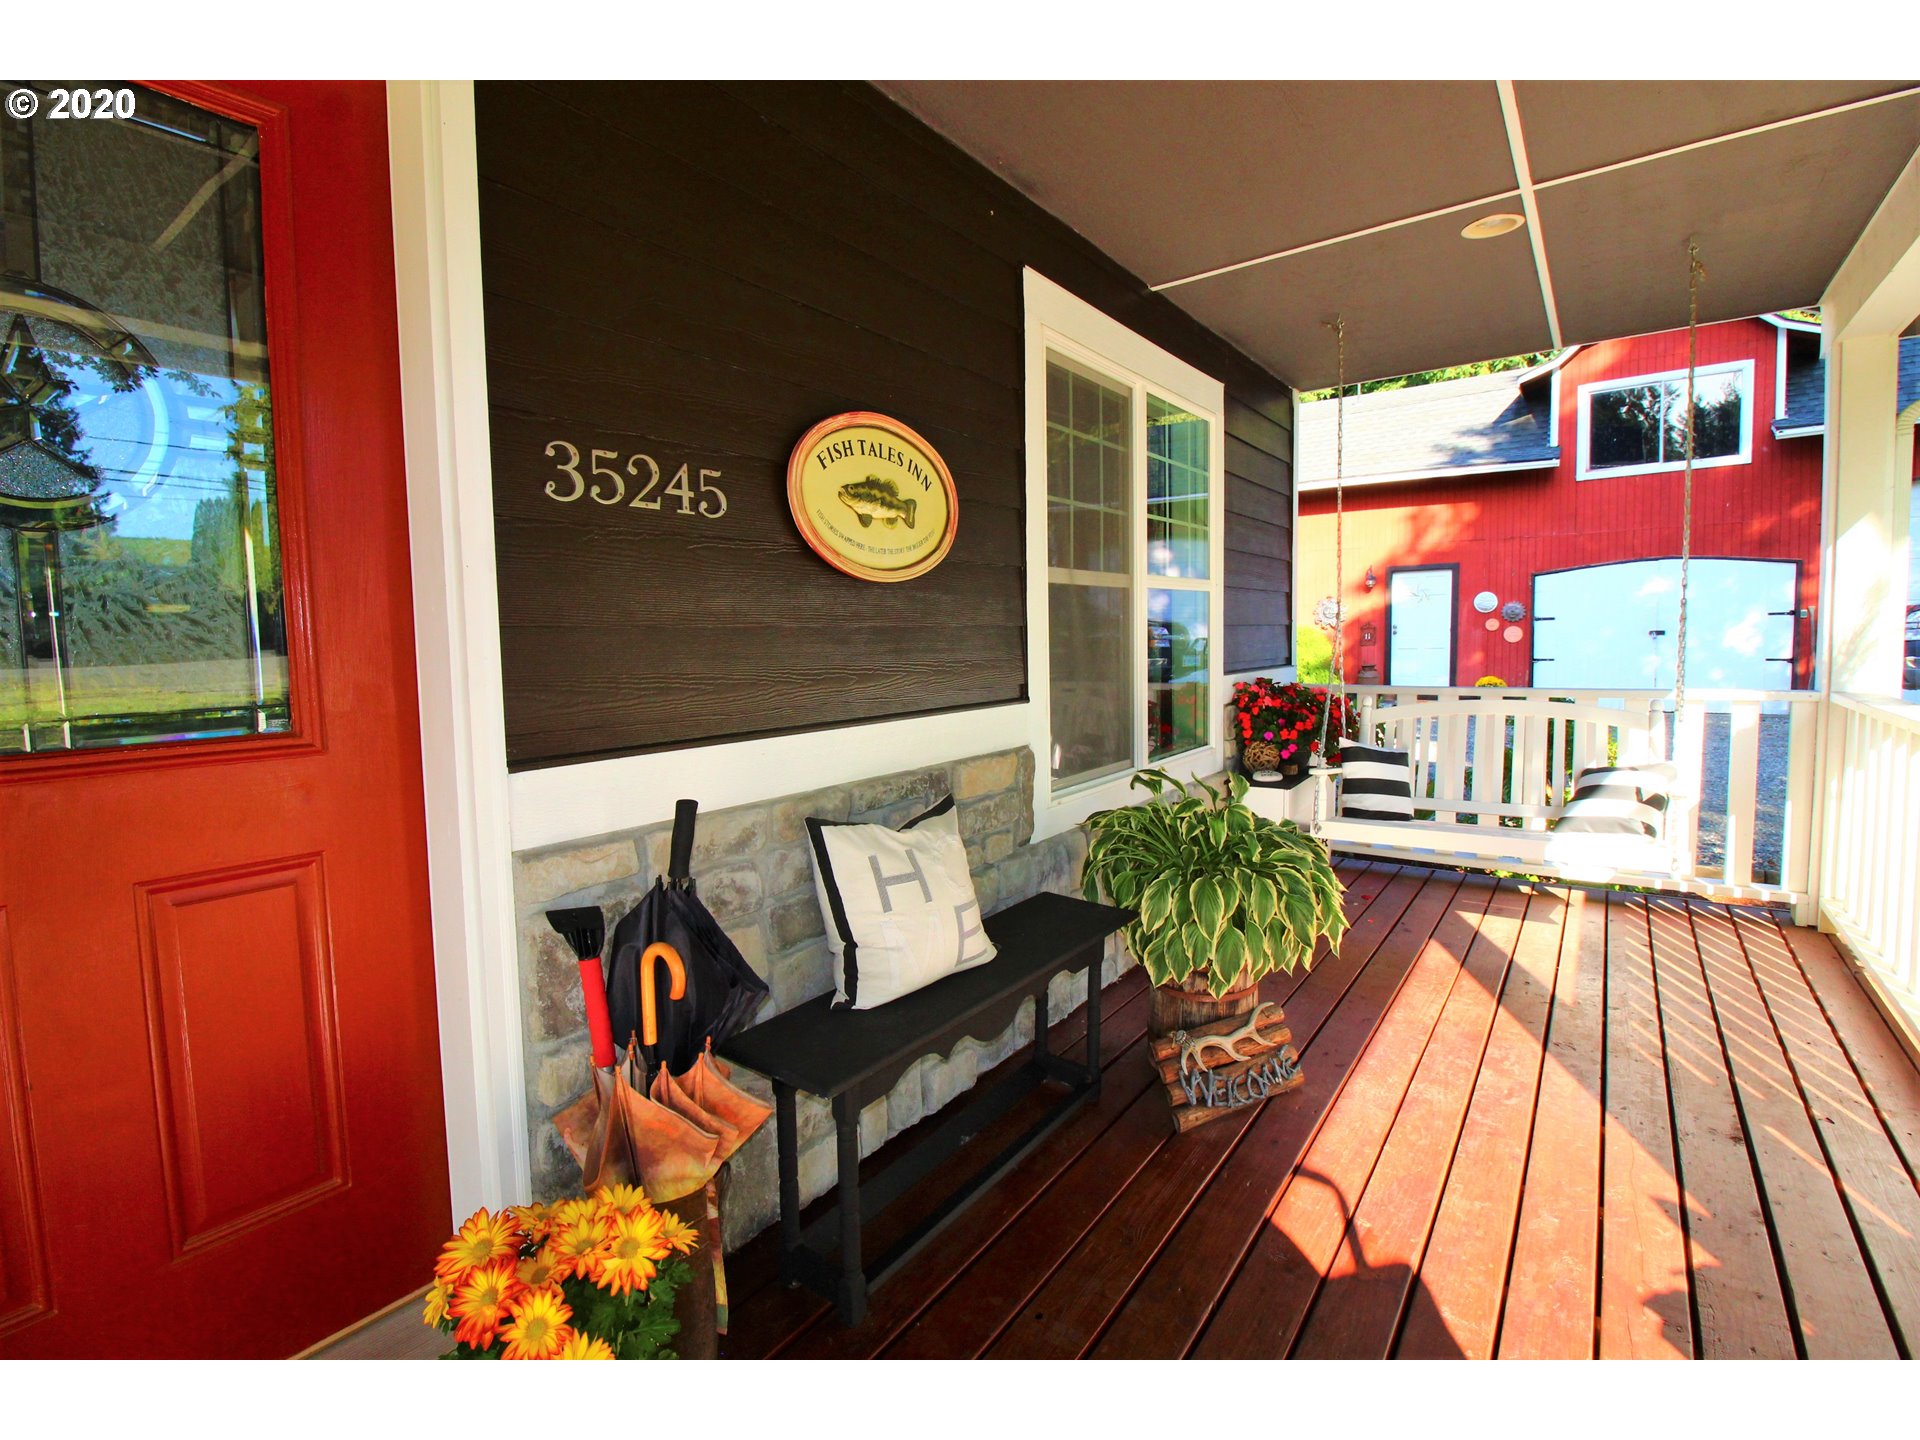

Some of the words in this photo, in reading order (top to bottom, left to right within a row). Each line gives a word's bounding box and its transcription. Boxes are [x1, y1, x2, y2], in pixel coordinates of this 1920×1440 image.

[544, 440, 727, 519] 35245
[816, 439, 855, 471] FISH
[857, 439, 904, 468] TALES
[907, 459, 933, 492] INN
[1178, 1044, 1301, 1109] WELCOME
